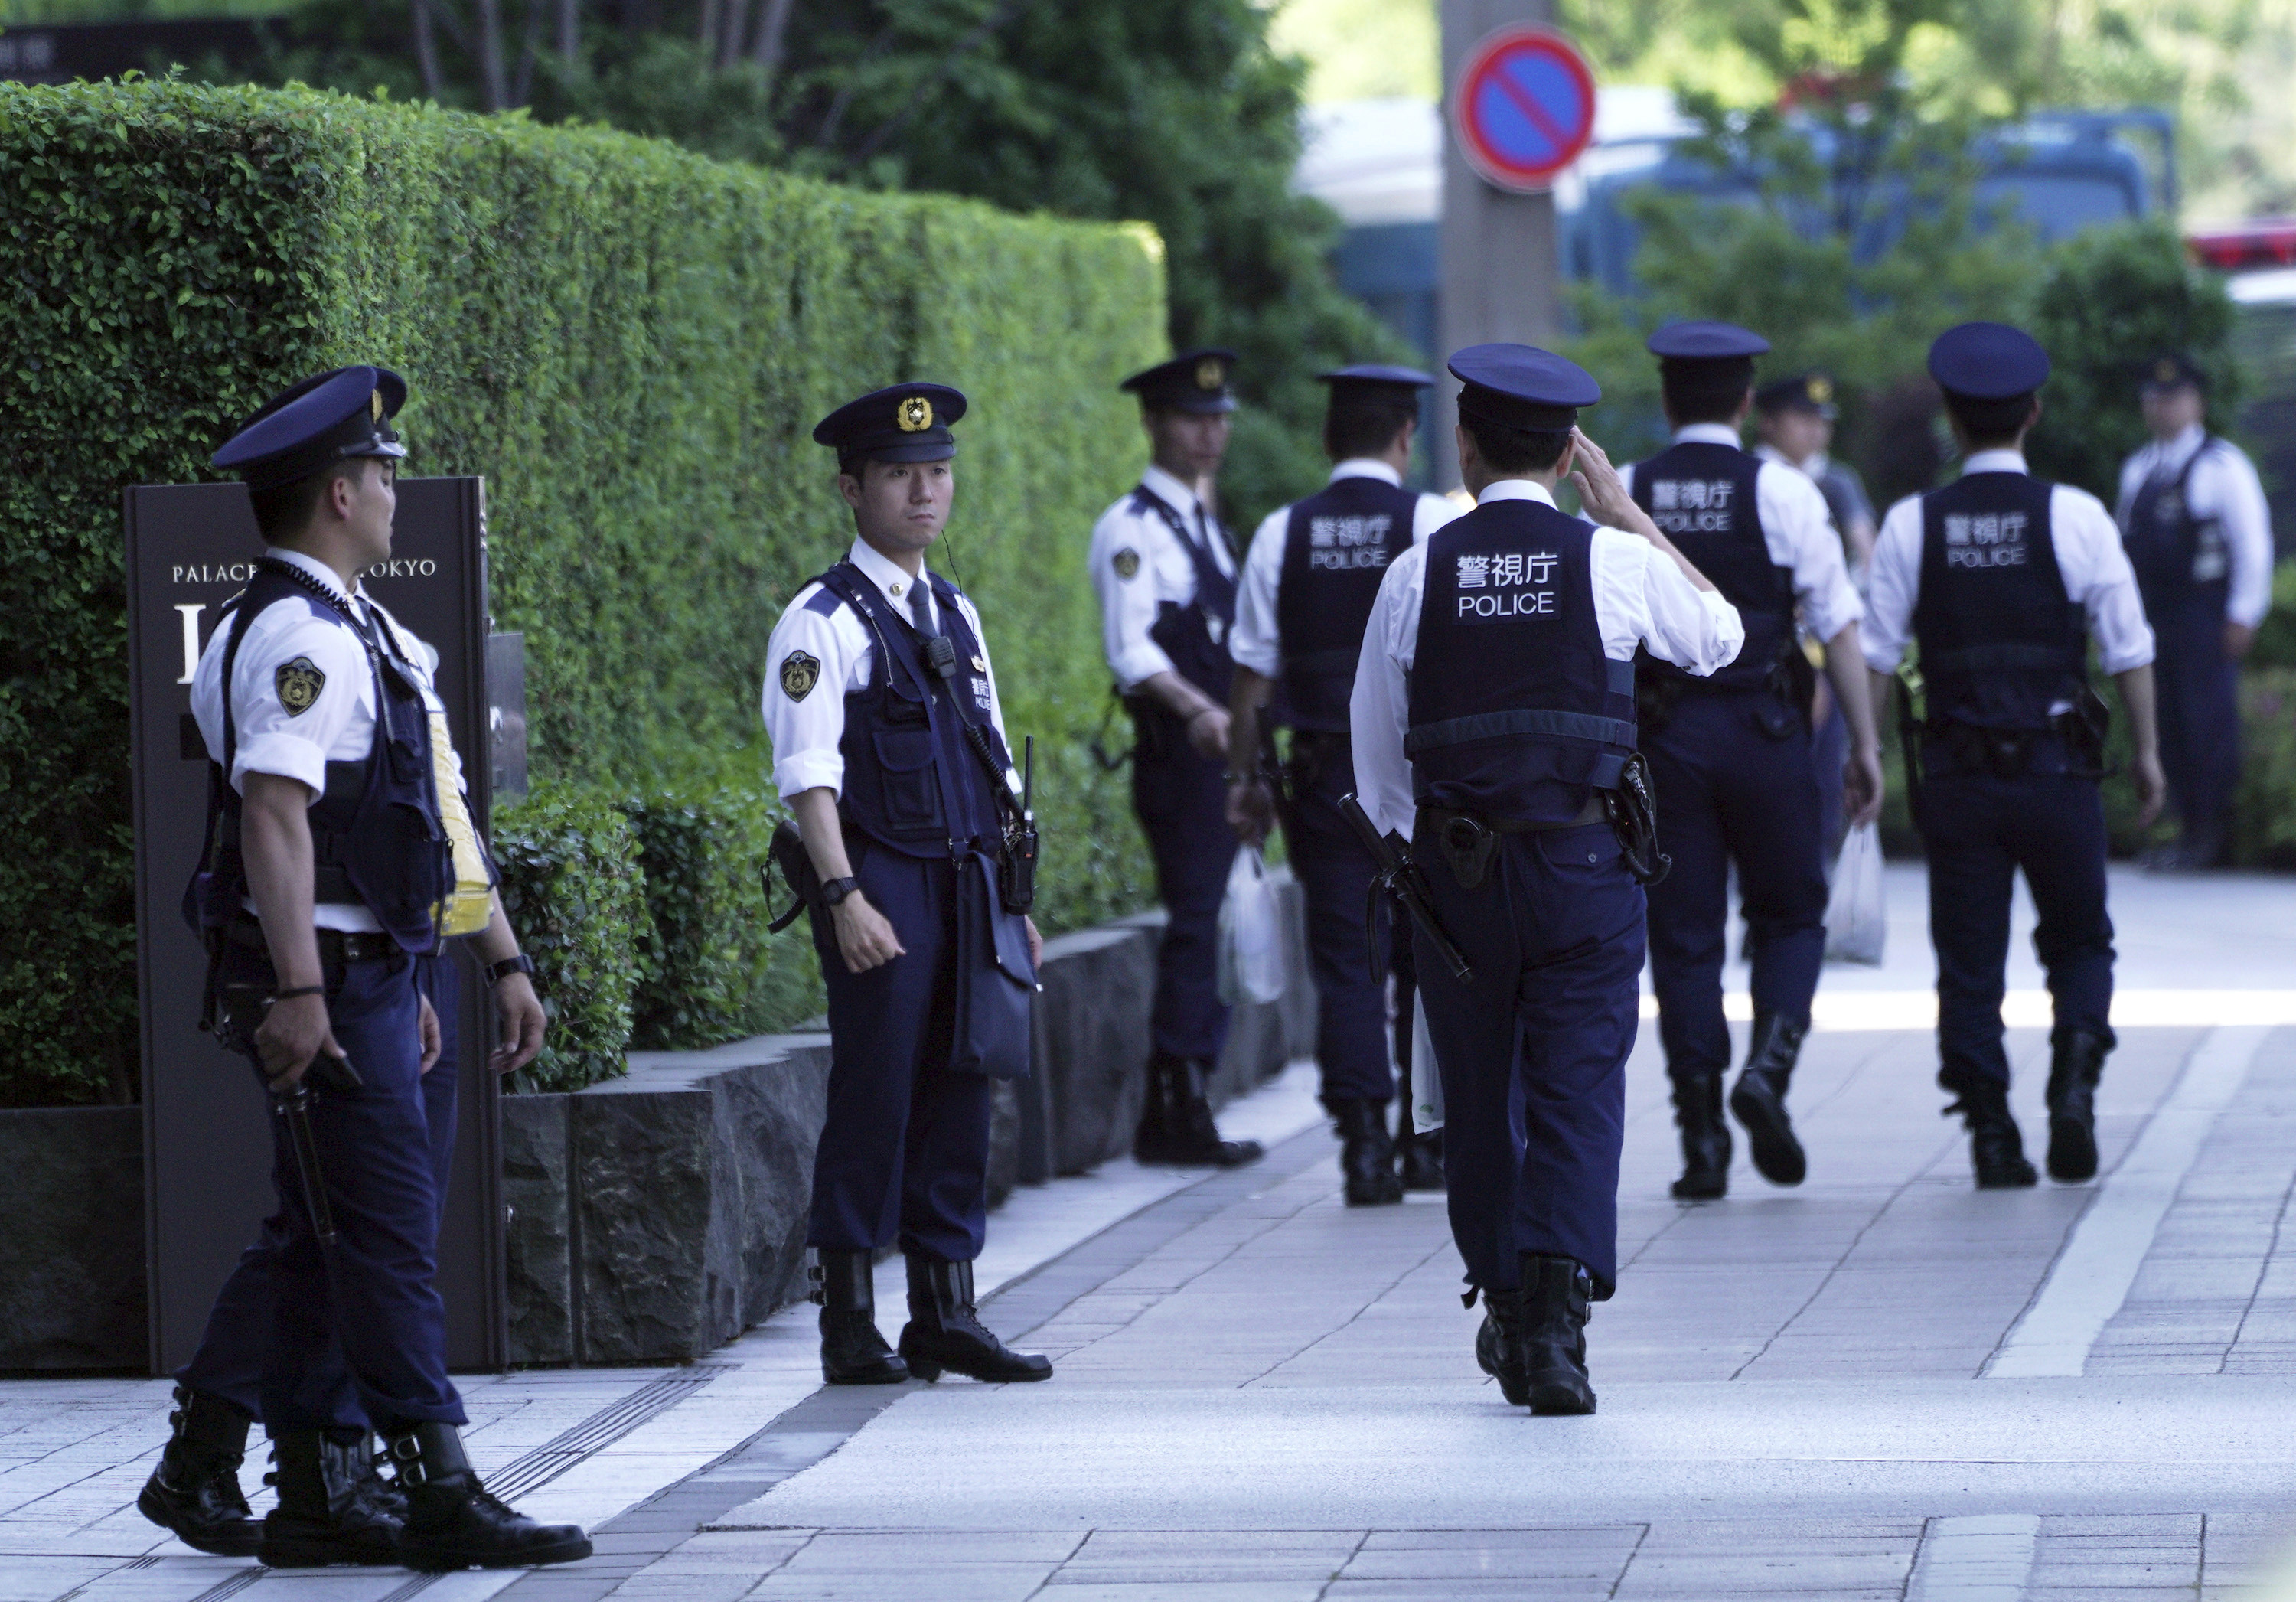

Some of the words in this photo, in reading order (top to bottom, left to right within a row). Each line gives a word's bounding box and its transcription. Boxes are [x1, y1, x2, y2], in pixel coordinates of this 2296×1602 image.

[1311, 516, 1391, 546] 警視庁
[1312, 550, 1388, 569] POLICE
[1948, 547, 2025, 567] POLICE
[360, 560, 435, 578] OKYO
[1456, 552, 1557, 588] 警視庁
[1459, 592, 1554, 617] POLICE
